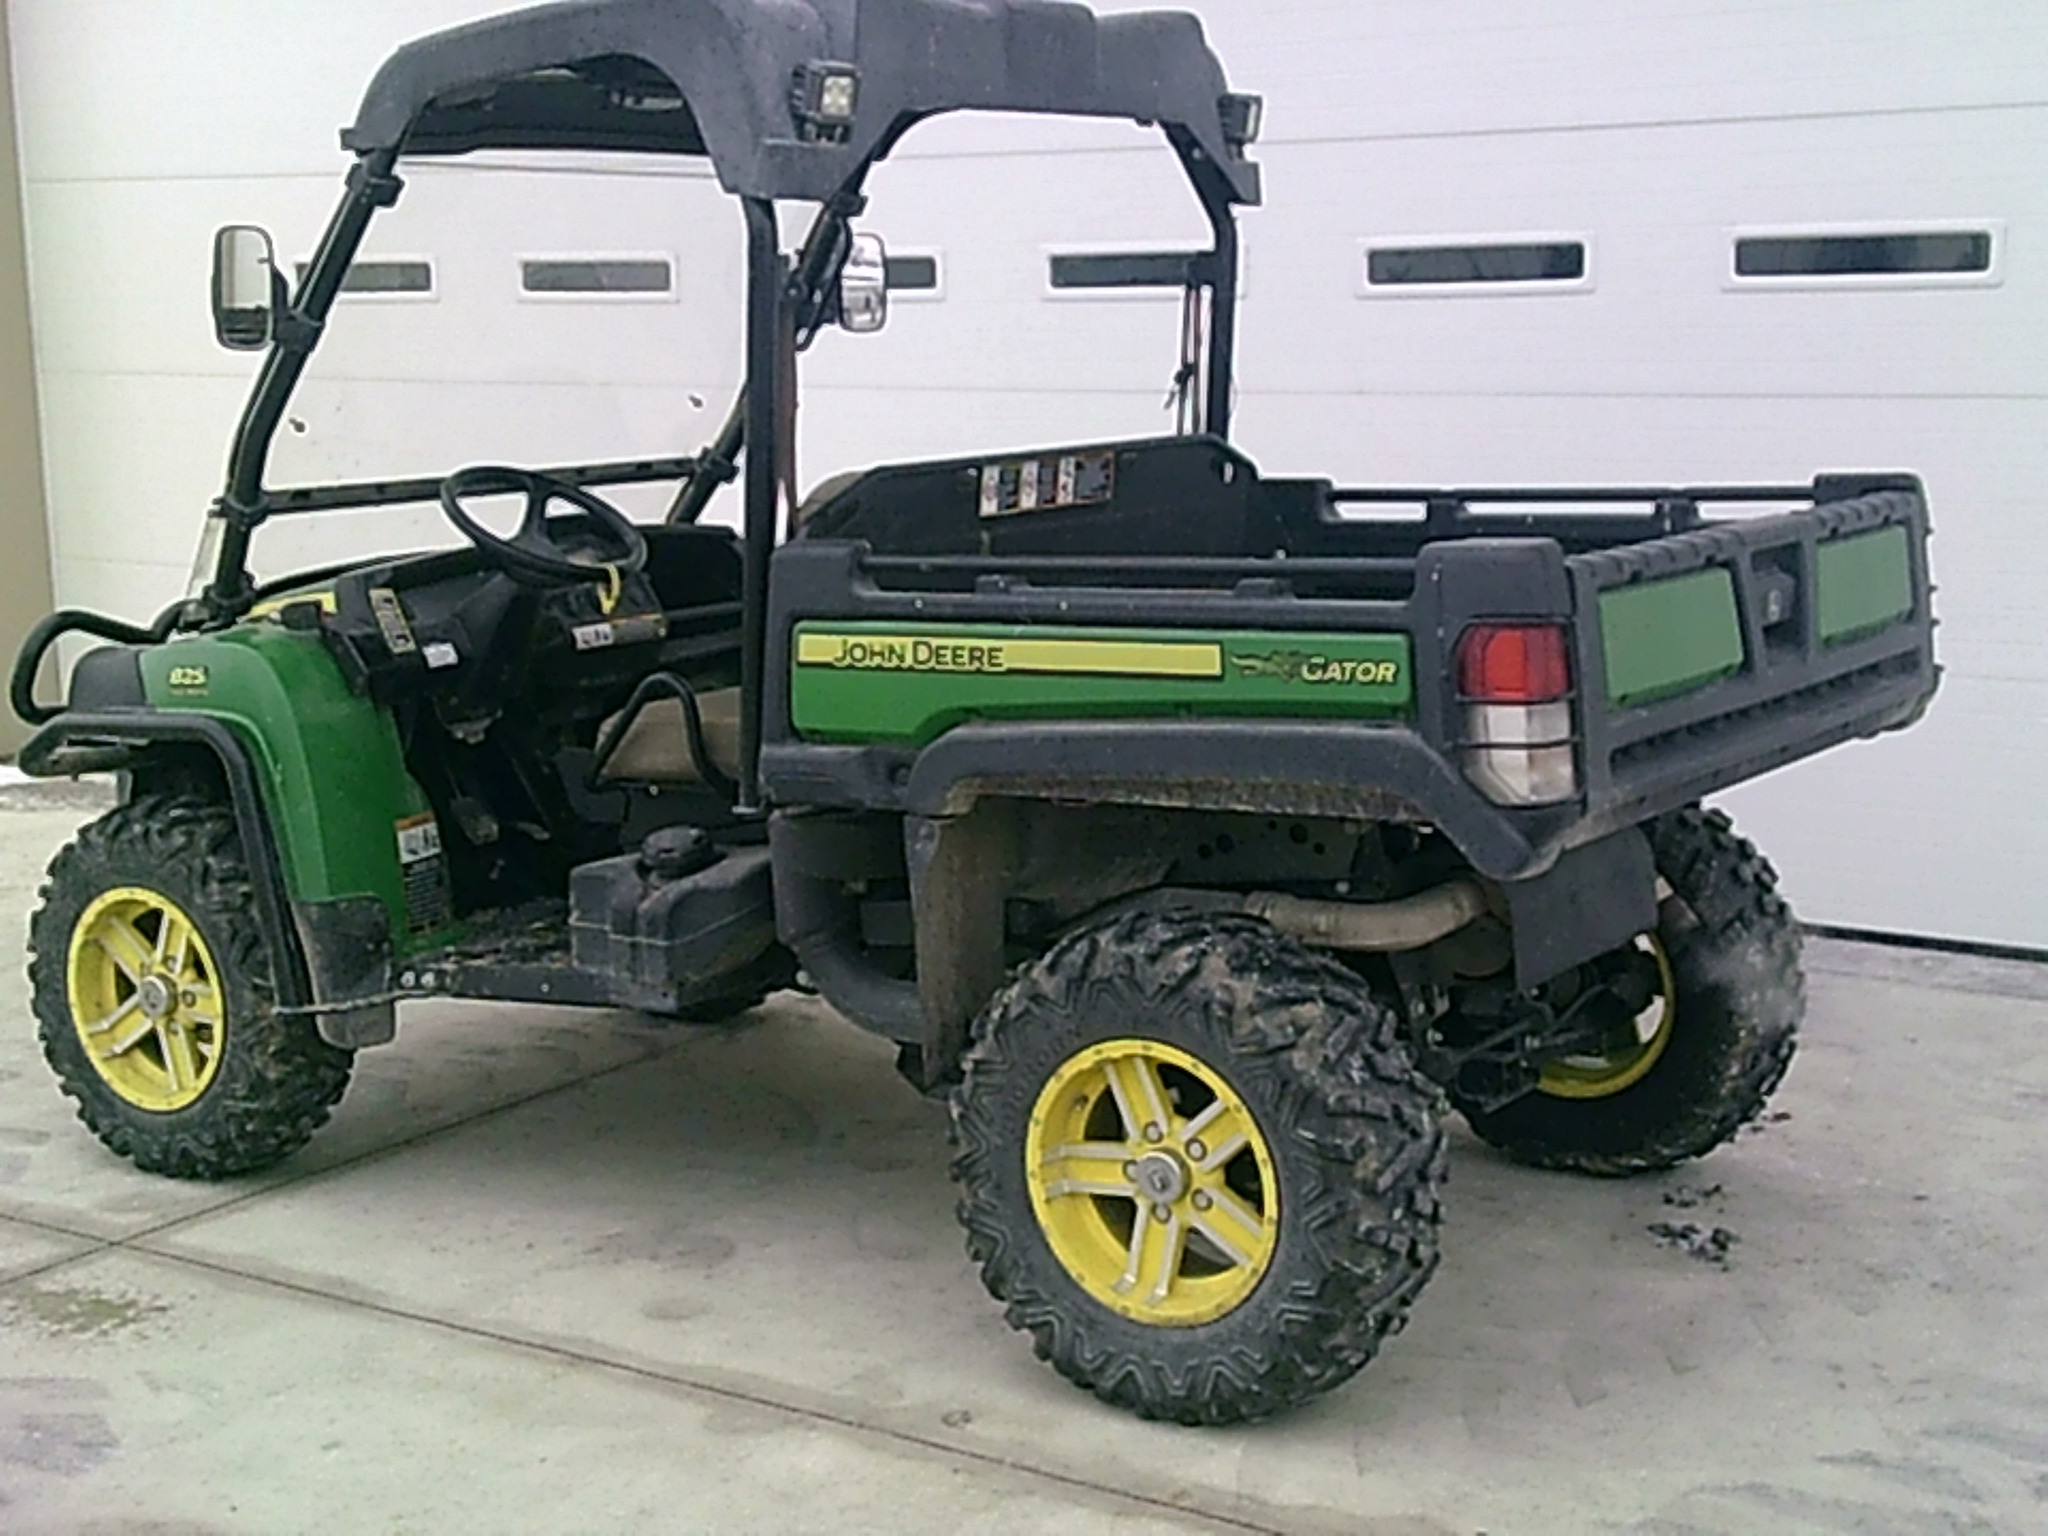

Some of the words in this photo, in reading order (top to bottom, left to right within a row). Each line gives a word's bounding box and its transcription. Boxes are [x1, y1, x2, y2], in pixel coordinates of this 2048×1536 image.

[833, 638, 907, 664] JOHN
[912, 640, 1003, 668] DEERE
[1301, 655, 1397, 684] GATOR
